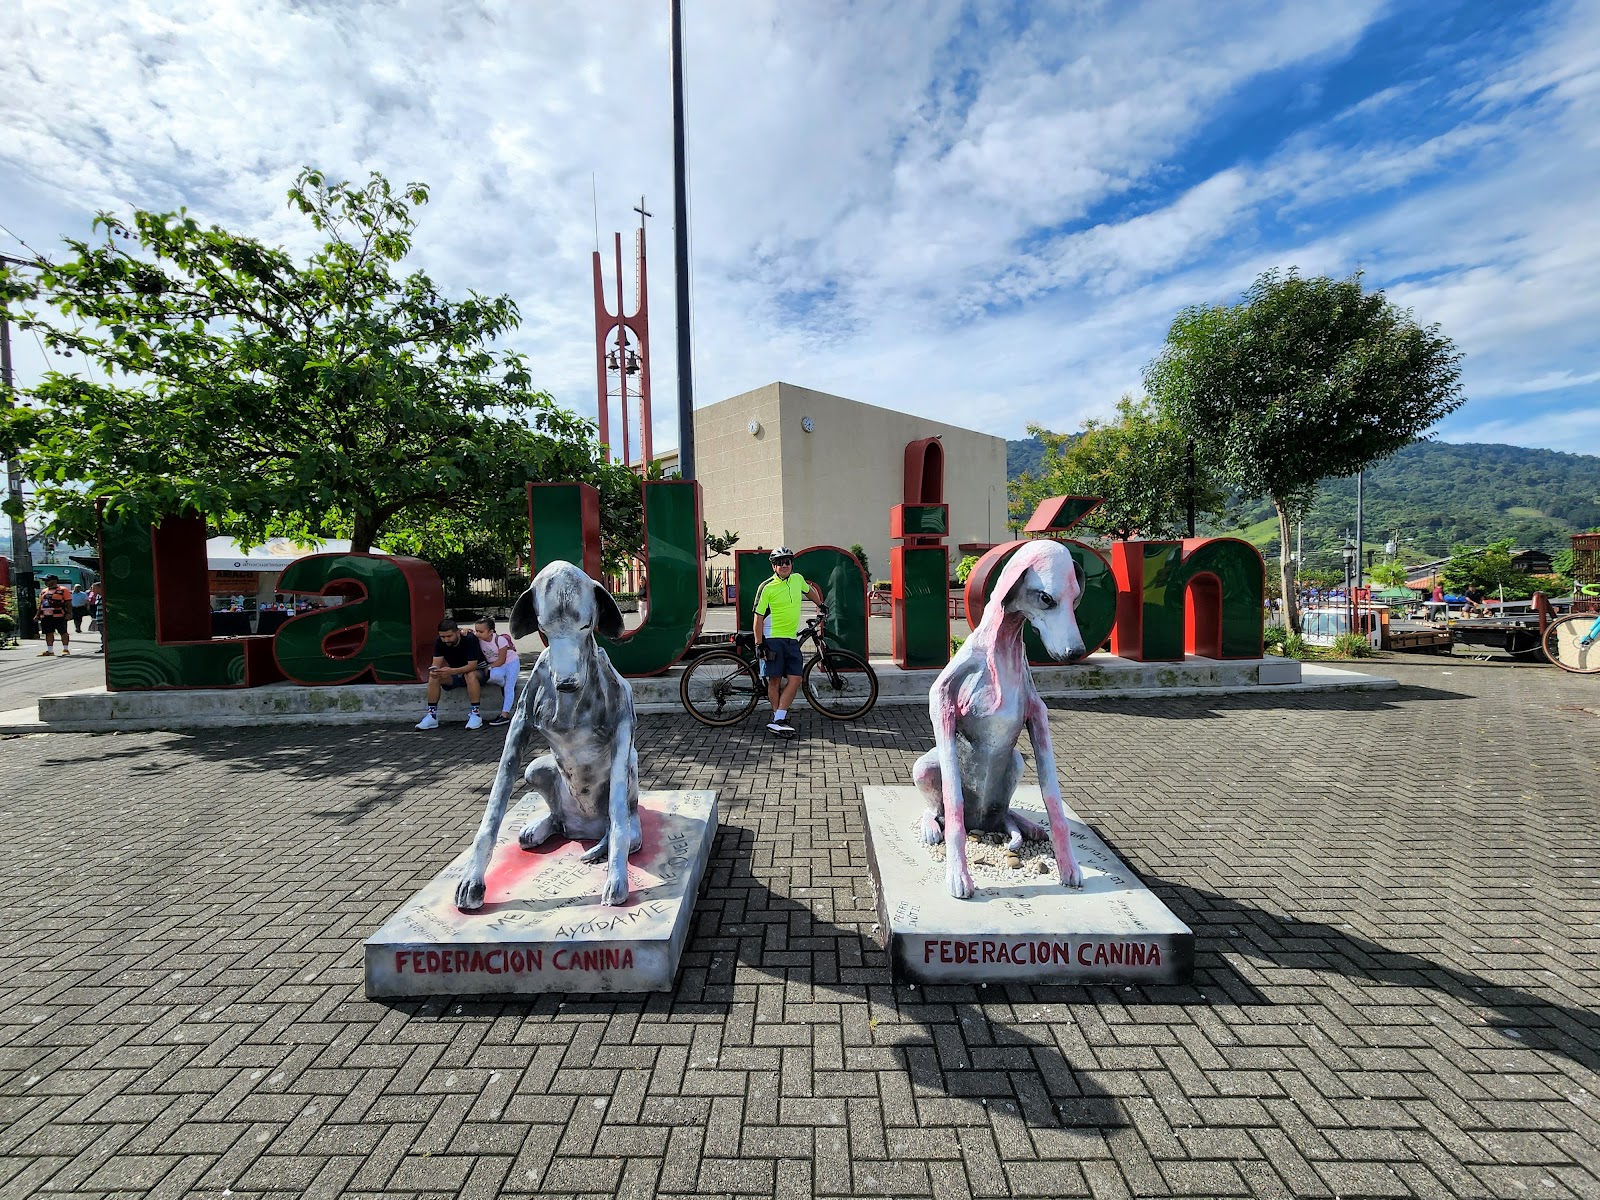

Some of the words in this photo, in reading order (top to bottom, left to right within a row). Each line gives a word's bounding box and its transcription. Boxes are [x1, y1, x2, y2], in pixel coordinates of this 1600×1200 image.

[98, 497, 443, 691] La
[527, 437, 1265, 676] Unión
[486, 912, 526, 931] ME
[555, 901, 673, 939] AYÚDAME
[893, 900, 909, 923] PERRO
[395, 948, 544, 974] FEDERACION
[551, 948, 634, 972] CANINA
[924, 940, 1071, 966] FEDERACION
[1077, 942, 1161, 968] CANINA
